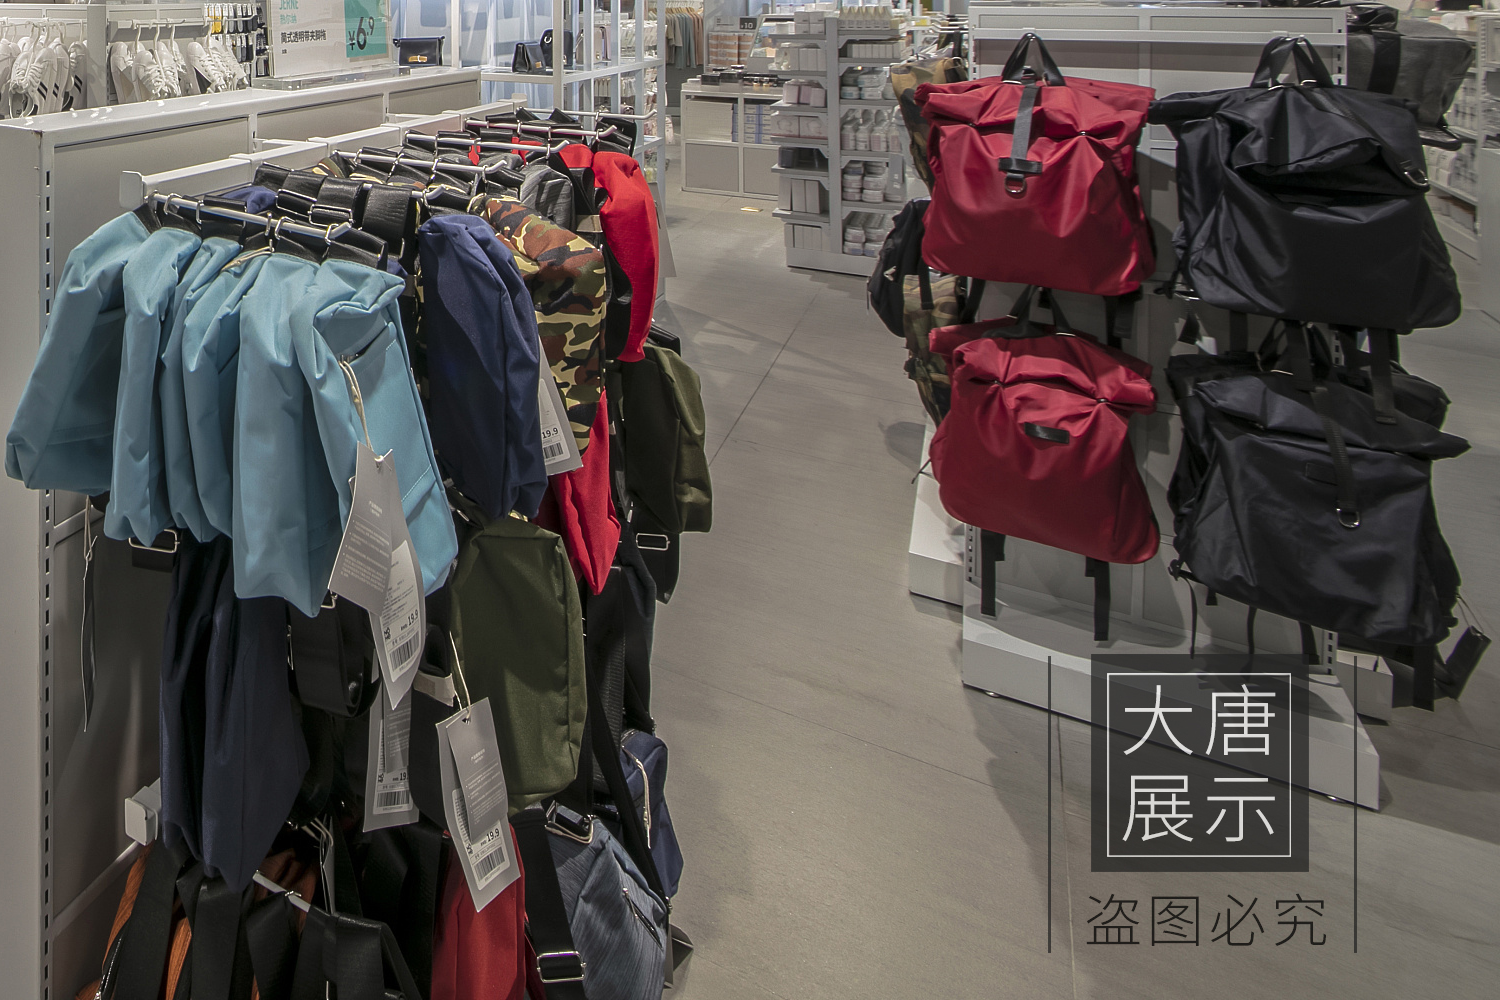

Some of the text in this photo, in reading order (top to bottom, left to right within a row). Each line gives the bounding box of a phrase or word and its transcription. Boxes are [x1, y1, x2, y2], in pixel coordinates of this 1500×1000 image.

[542, 427, 559, 439] 19.9
[407, 609, 419, 626] 19.9
[486, 828, 500, 842] 19.9
